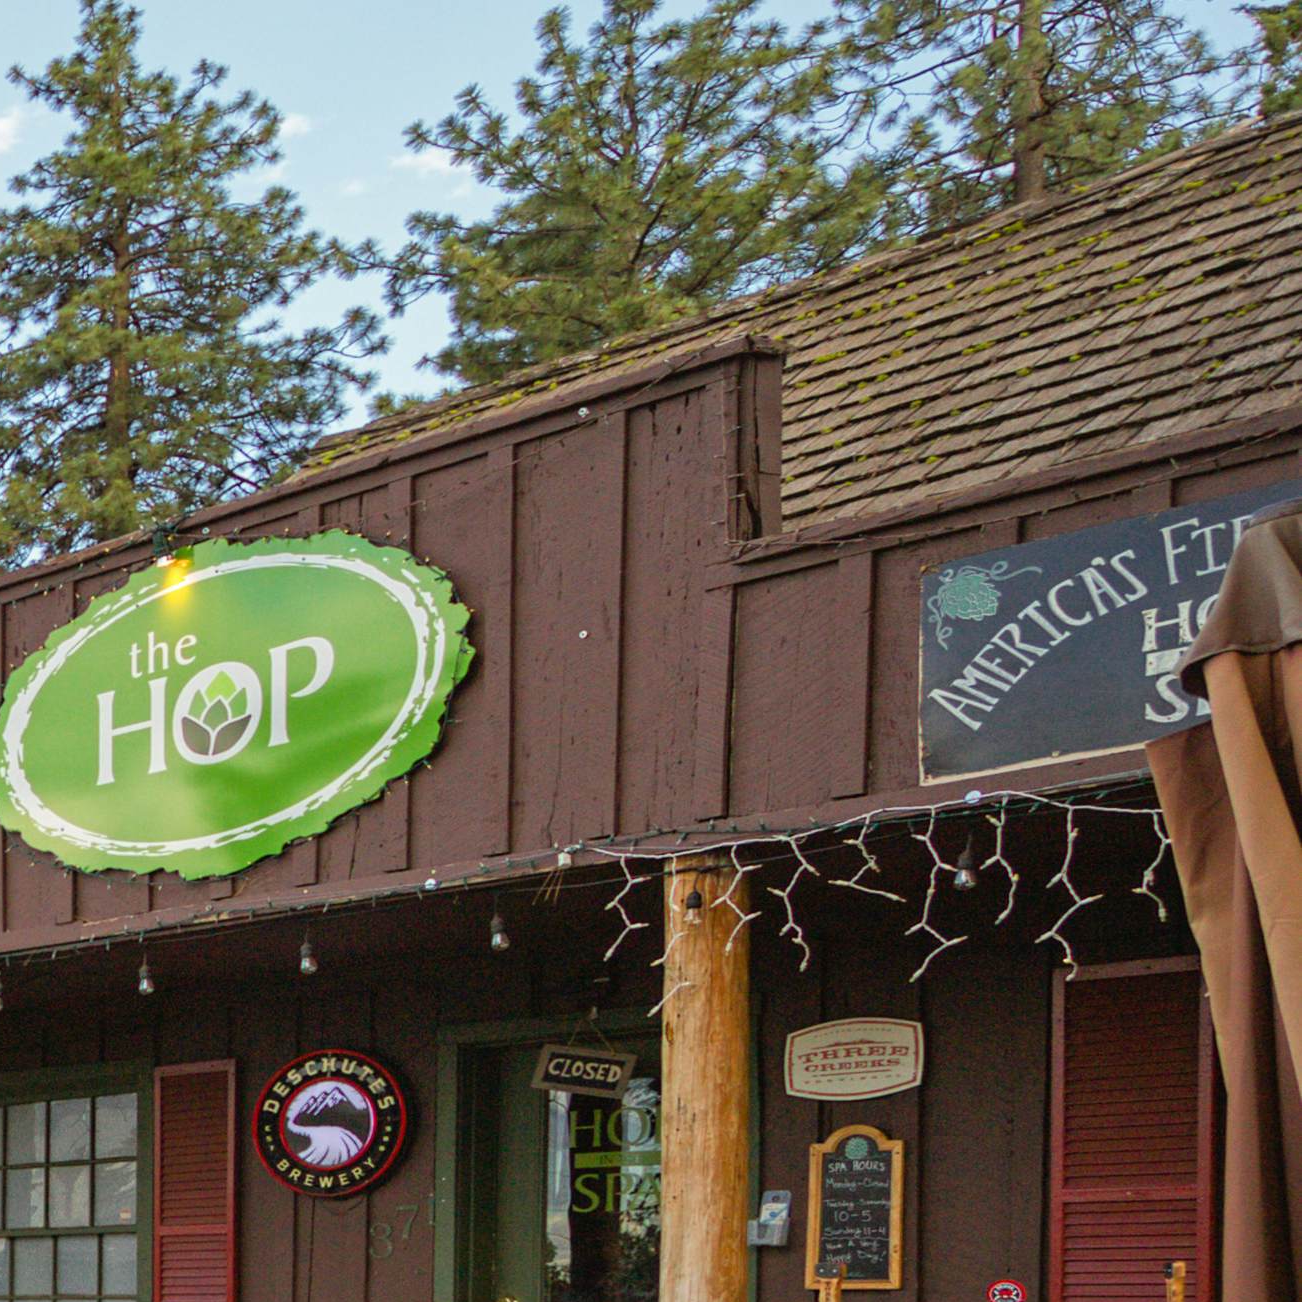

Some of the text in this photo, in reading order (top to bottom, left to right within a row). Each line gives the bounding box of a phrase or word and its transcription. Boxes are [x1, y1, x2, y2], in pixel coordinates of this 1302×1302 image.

[129, 631, 198, 678] the
[928, 549, 1147, 730] AMERICA'S
[96, 636, 335, 786] HOP
[548, 1058, 622, 1083] CLOSED
[797, 1045, 910, 1064] THREE
[804, 1058, 900, 1073] CREEKS
[262, 1058, 396, 1114] DESCHUTES
[569, 1107, 662, 1148] HO
[276, 1157, 376, 1188] BREWERY
[827, 1159, 886, 1174] SPA HOURS
